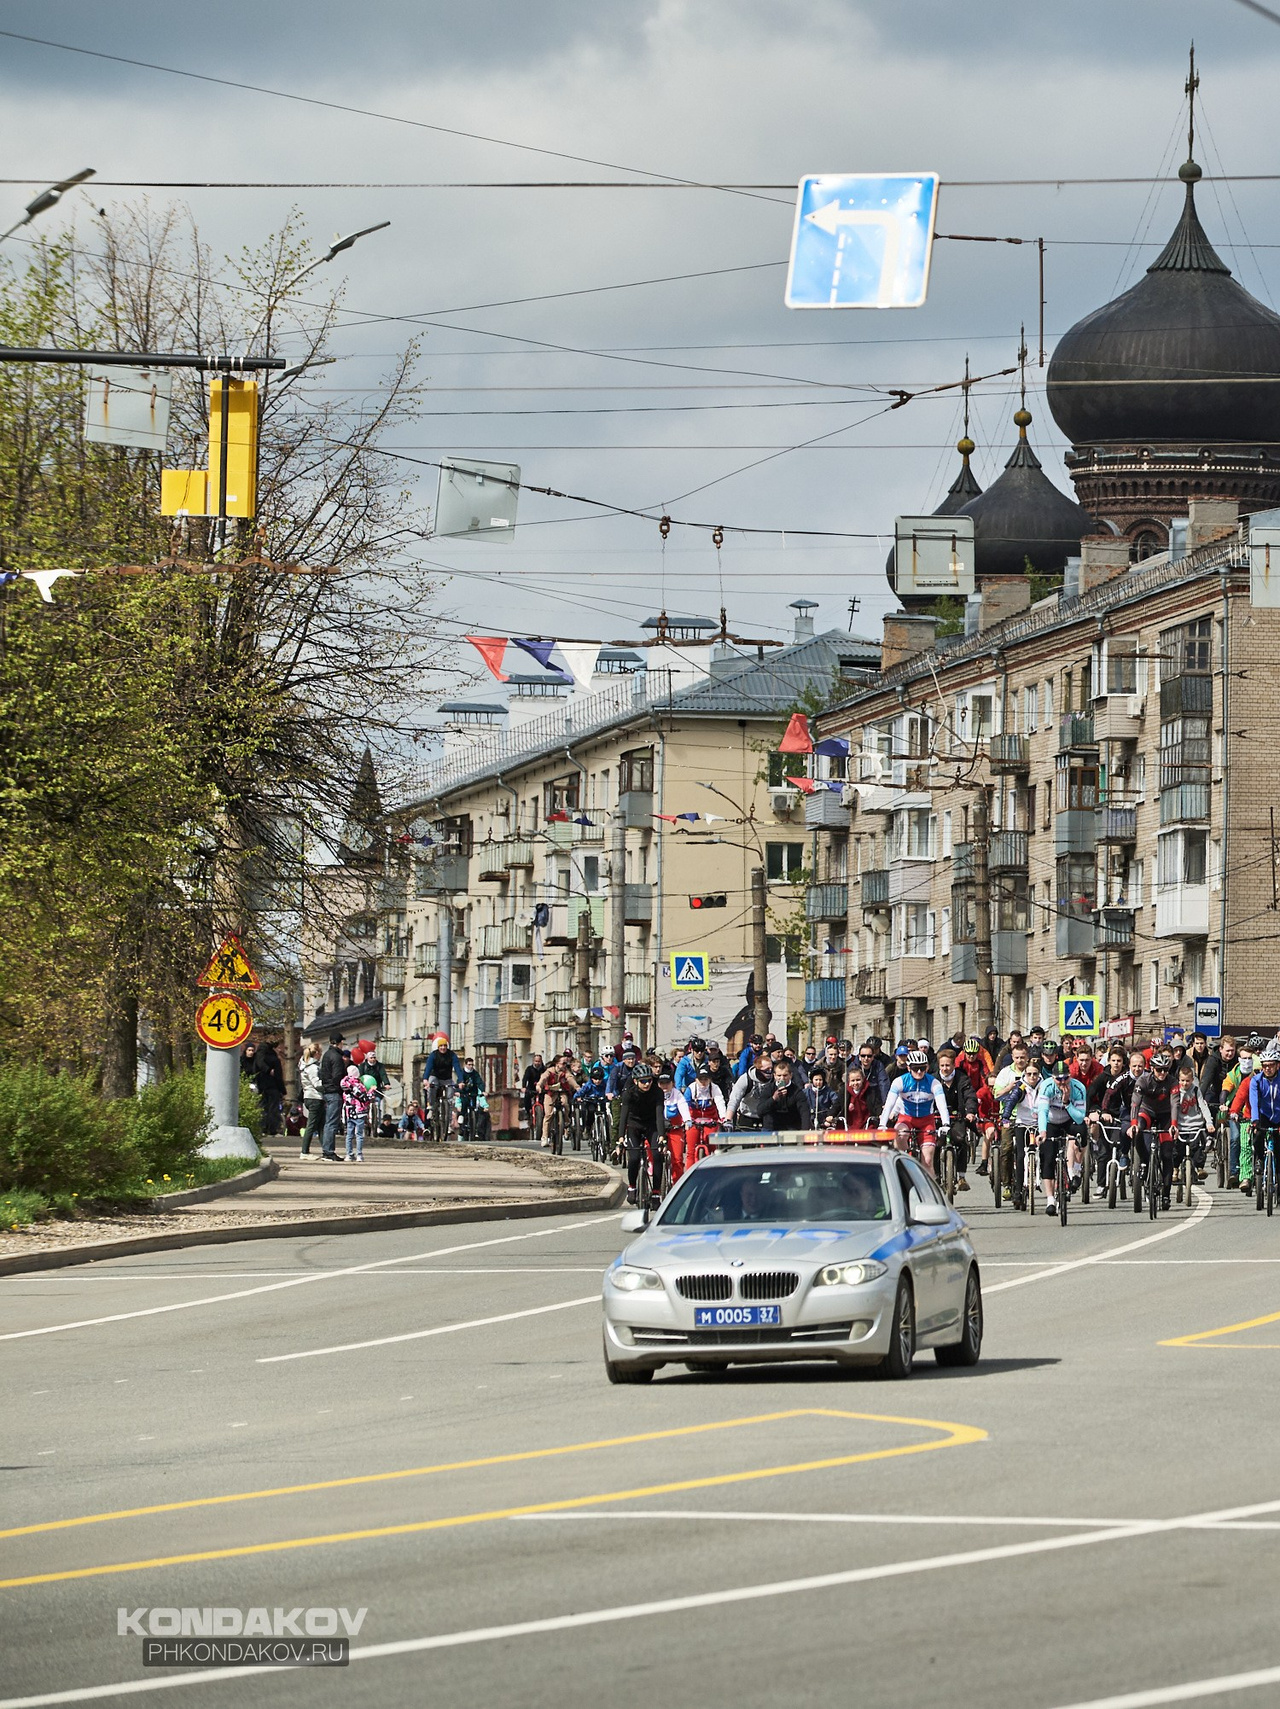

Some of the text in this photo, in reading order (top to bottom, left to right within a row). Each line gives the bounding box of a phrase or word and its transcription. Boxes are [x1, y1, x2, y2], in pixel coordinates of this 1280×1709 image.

[208, 1009, 240, 1032] 40
[716, 1308, 752, 1324] 0005
[760, 1307, 774, 1319] 37
